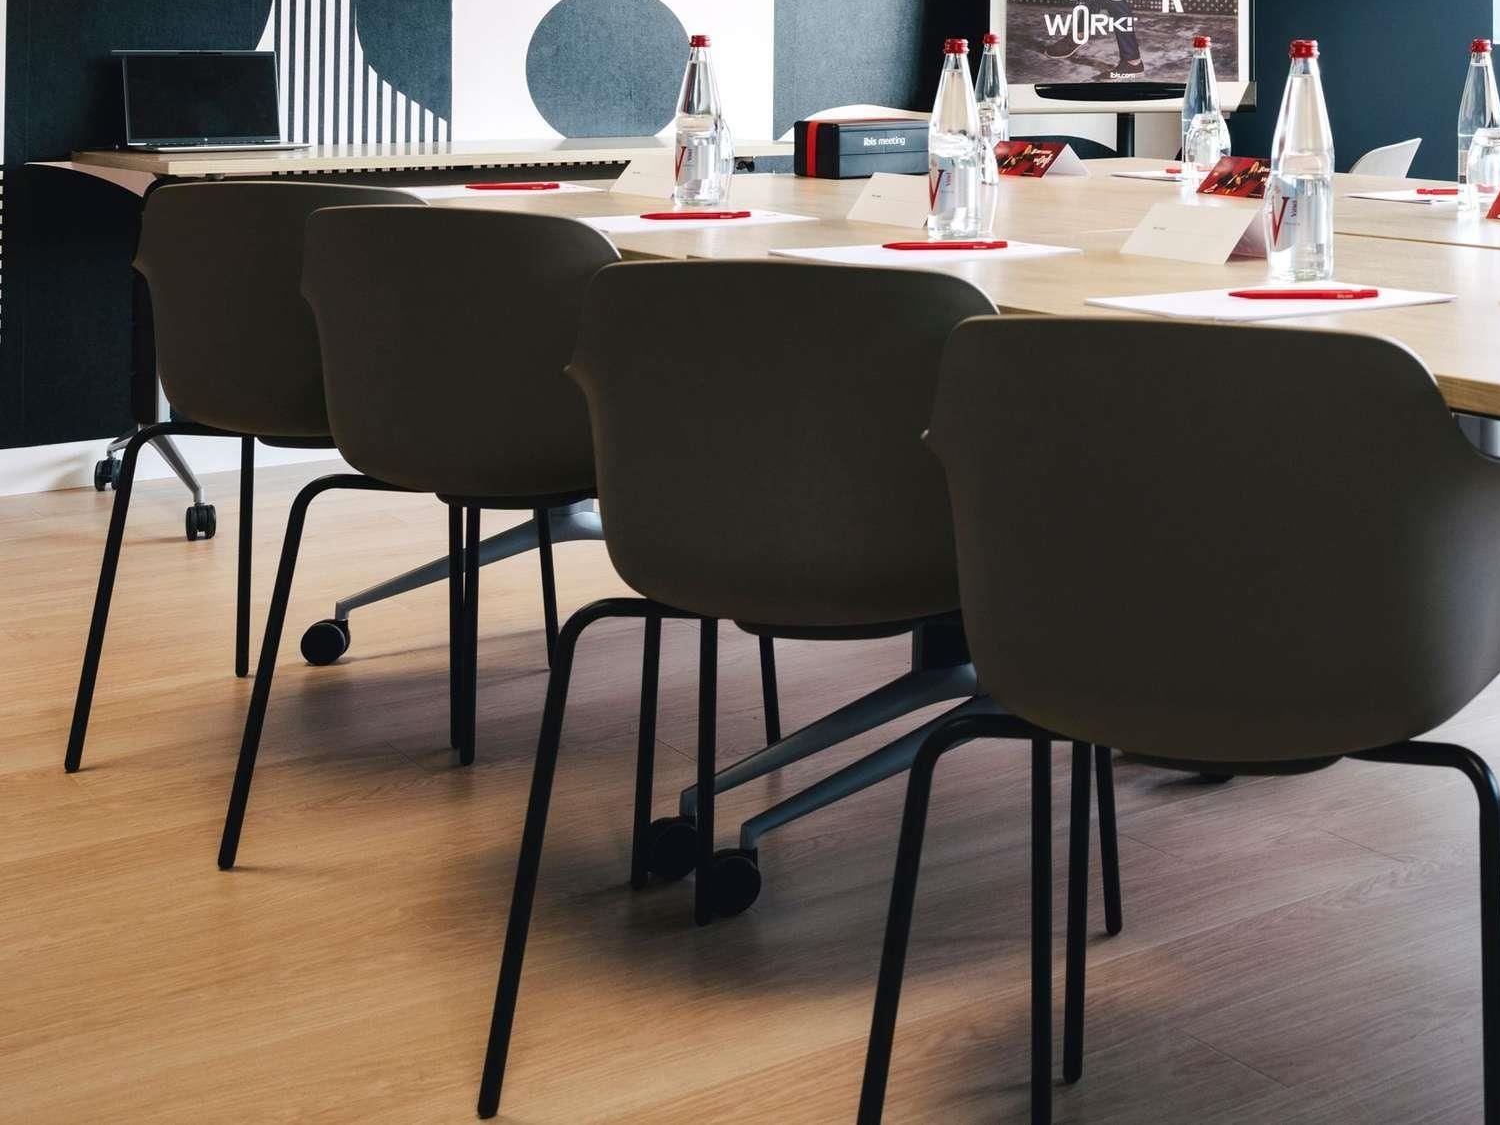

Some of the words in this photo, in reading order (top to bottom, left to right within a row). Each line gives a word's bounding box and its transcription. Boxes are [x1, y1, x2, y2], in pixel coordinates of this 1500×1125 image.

[1044, 5, 1133, 45] WORK!
[863, 137, 877, 146] ibis
[878, 136, 906, 146] meeting
